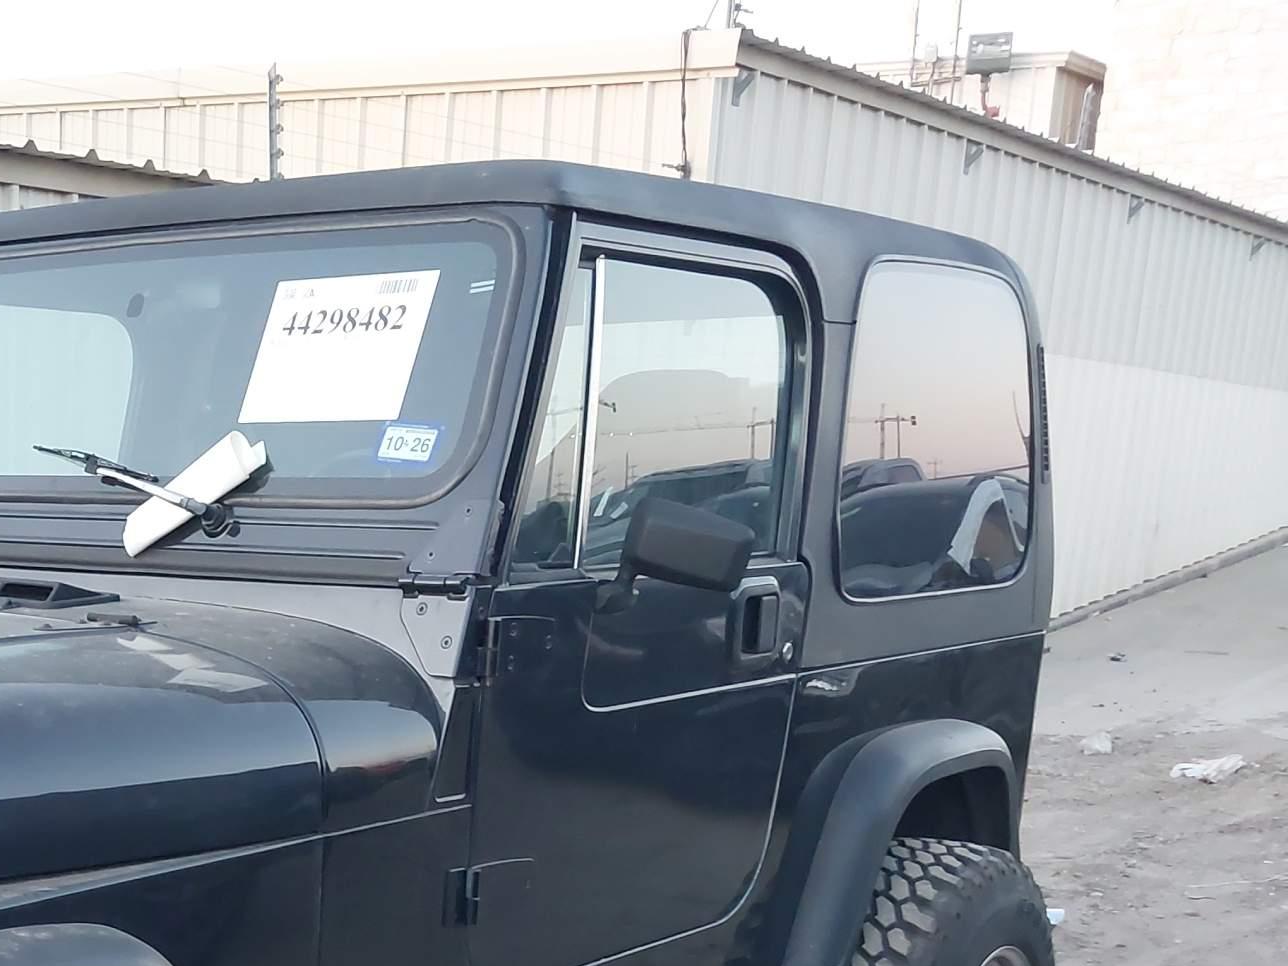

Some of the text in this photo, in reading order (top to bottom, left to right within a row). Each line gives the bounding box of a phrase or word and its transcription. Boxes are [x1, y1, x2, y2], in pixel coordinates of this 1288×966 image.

[282, 304, 408, 336] 44298482
[386, 435, 432, 454] 10 26
